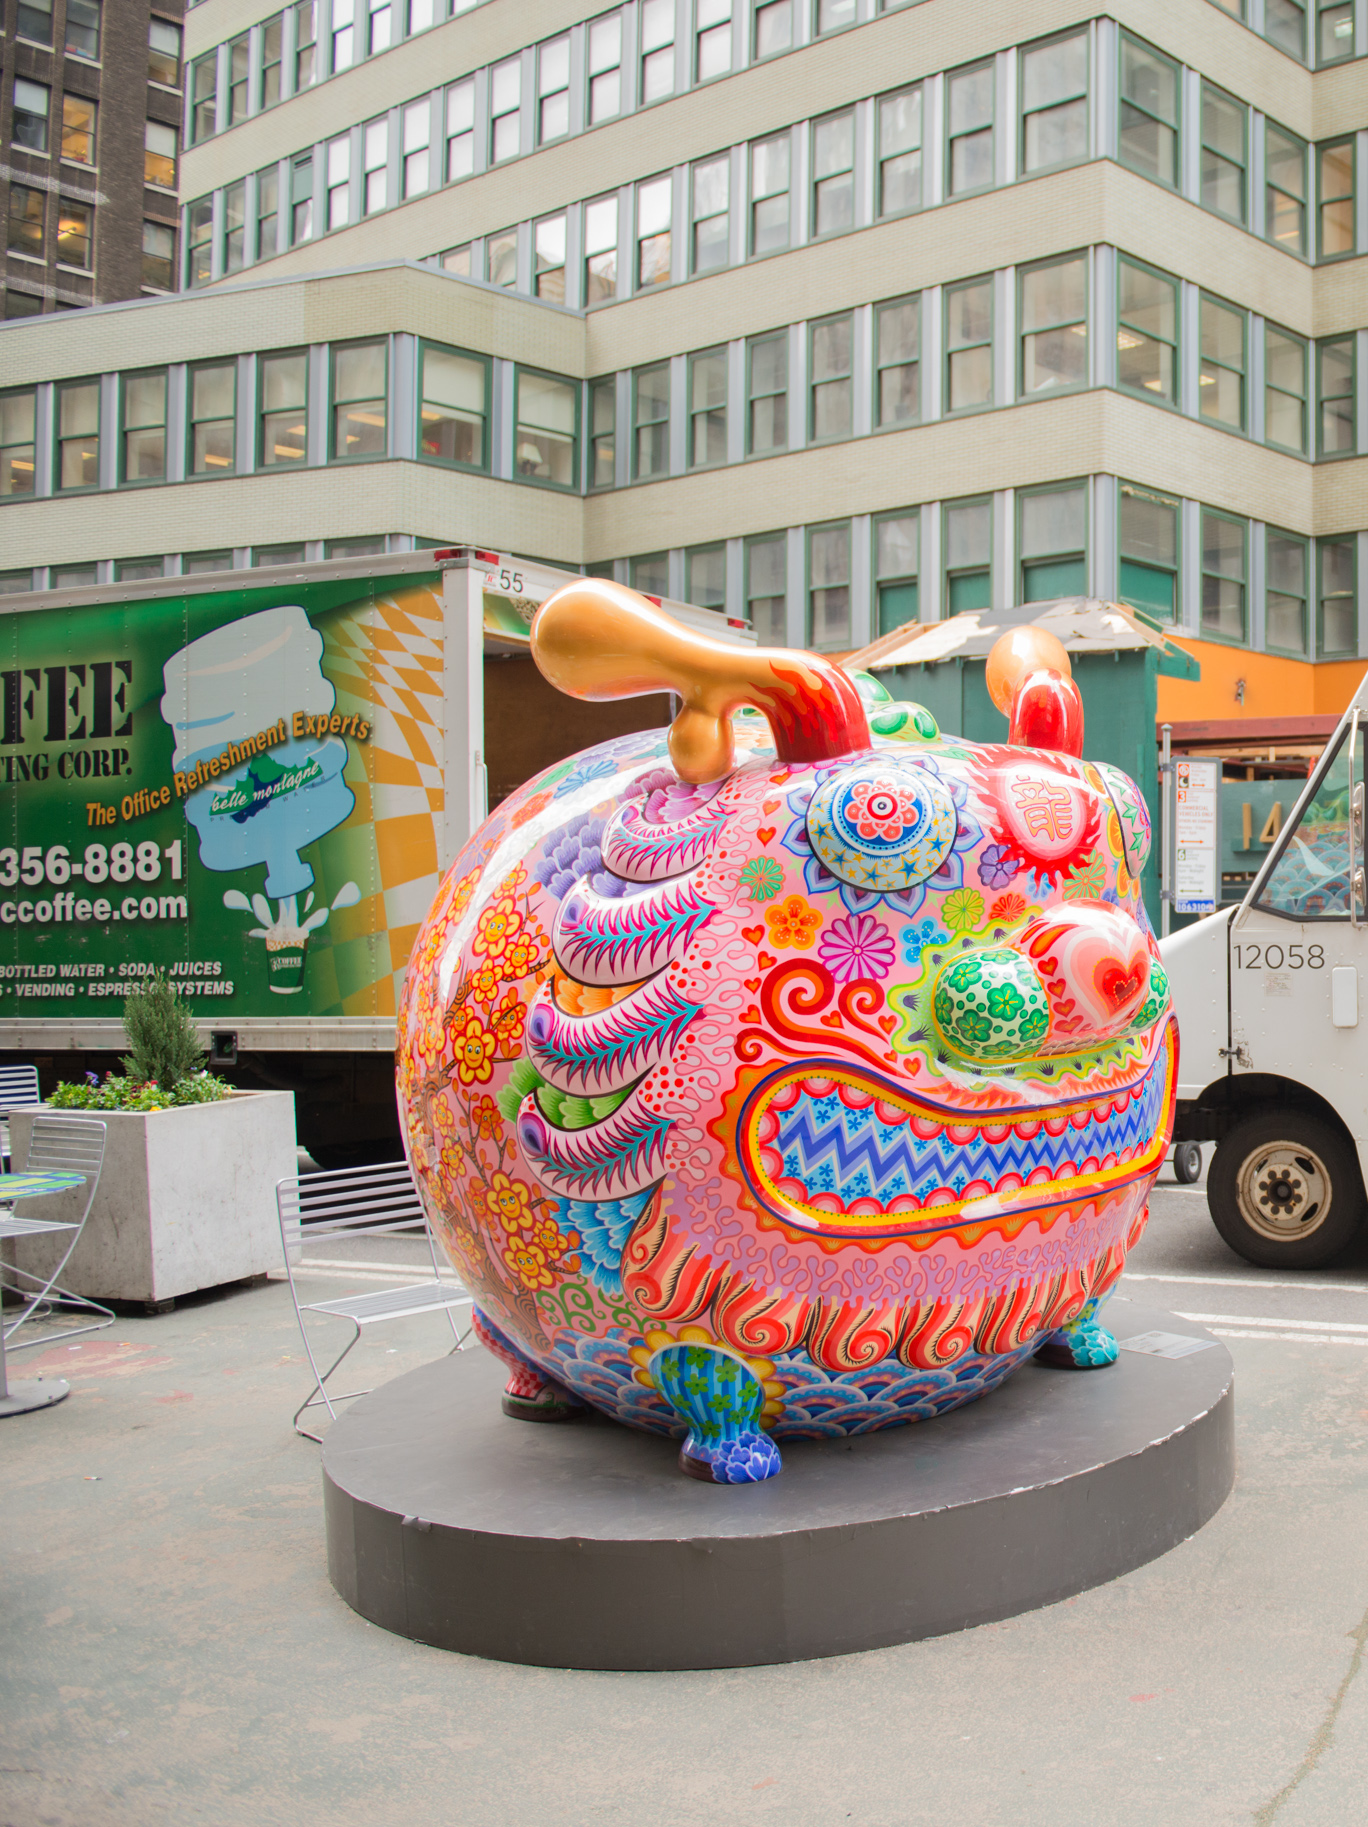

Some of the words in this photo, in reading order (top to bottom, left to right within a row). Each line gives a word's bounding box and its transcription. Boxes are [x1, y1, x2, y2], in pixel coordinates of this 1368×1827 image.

[500, 569, 523, 593] 55
[1, 660, 132, 745] FEE
[57, 748, 133, 780] CORP.
[86, 802, 116, 826] The
[121, 785, 171, 820] Office
[173, 718, 286, 796] Refreshment
[292, 711, 370, 739] Experts
[212, 791, 248, 812] belle
[253, 761, 319, 801] montagne
[0, 839, 182, 886] 356-8881
[1, 891, 188, 923] ccoffee.com
[60, 964, 105, 978] WATER
[118, 962, 156, 977] SODA
[169, 962, 222, 976] JUICES
[1233, 944, 1325, 969] 12058
[15, 983, 75, 997] VENDING
